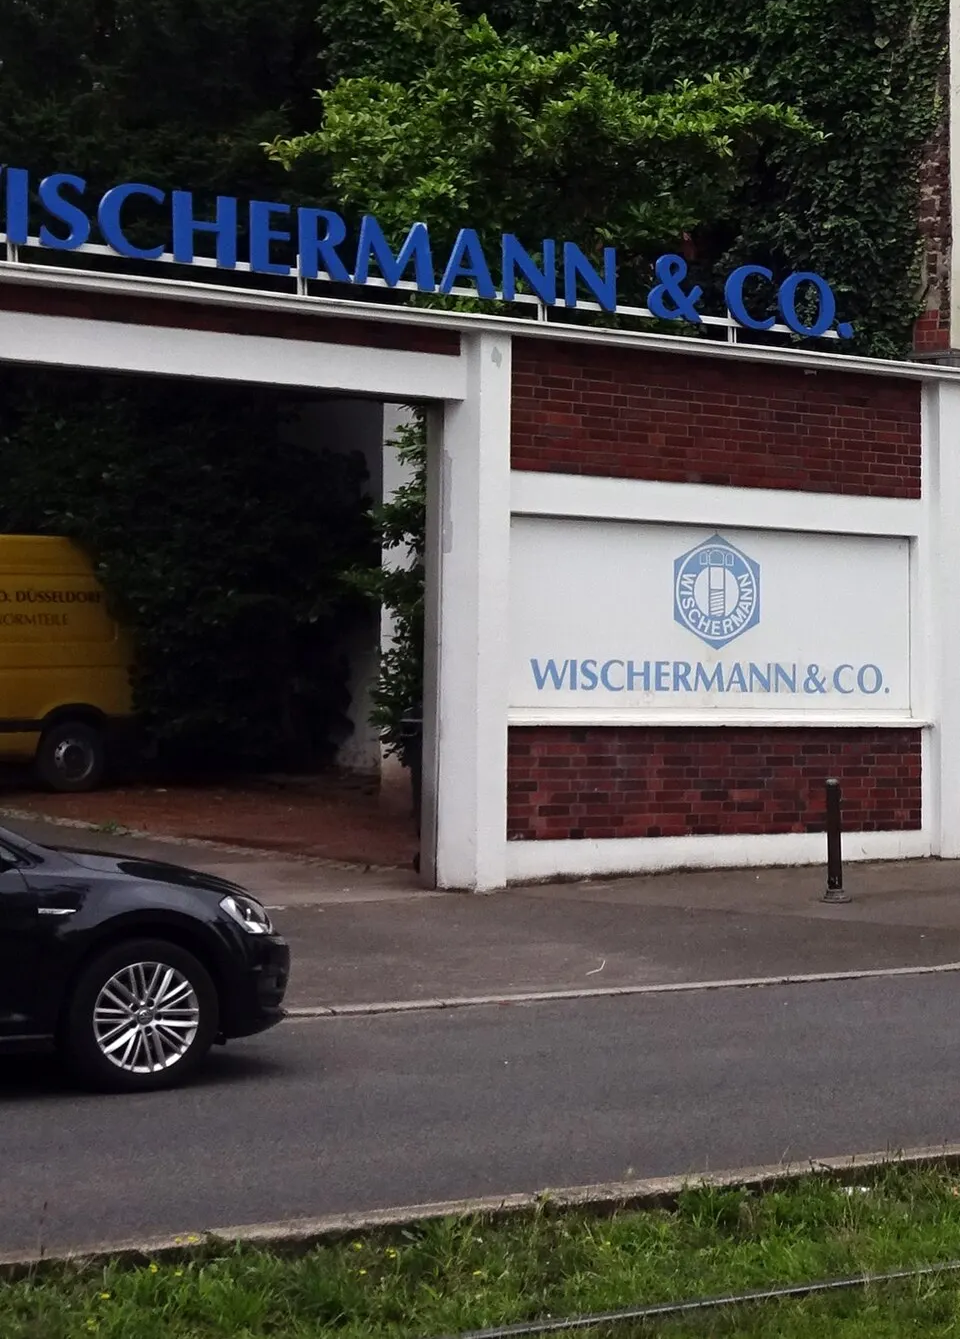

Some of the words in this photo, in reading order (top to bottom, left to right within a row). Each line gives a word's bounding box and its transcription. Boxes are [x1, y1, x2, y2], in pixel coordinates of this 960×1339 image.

[0, 164, 617, 312] ISCHERMANN
[647, 254, 703, 323] &
[724, 264, 854, 339] CO.
[0, 613, 68, 625] ORMTEILE
[680, 573, 753, 635] WISCHERMANN
